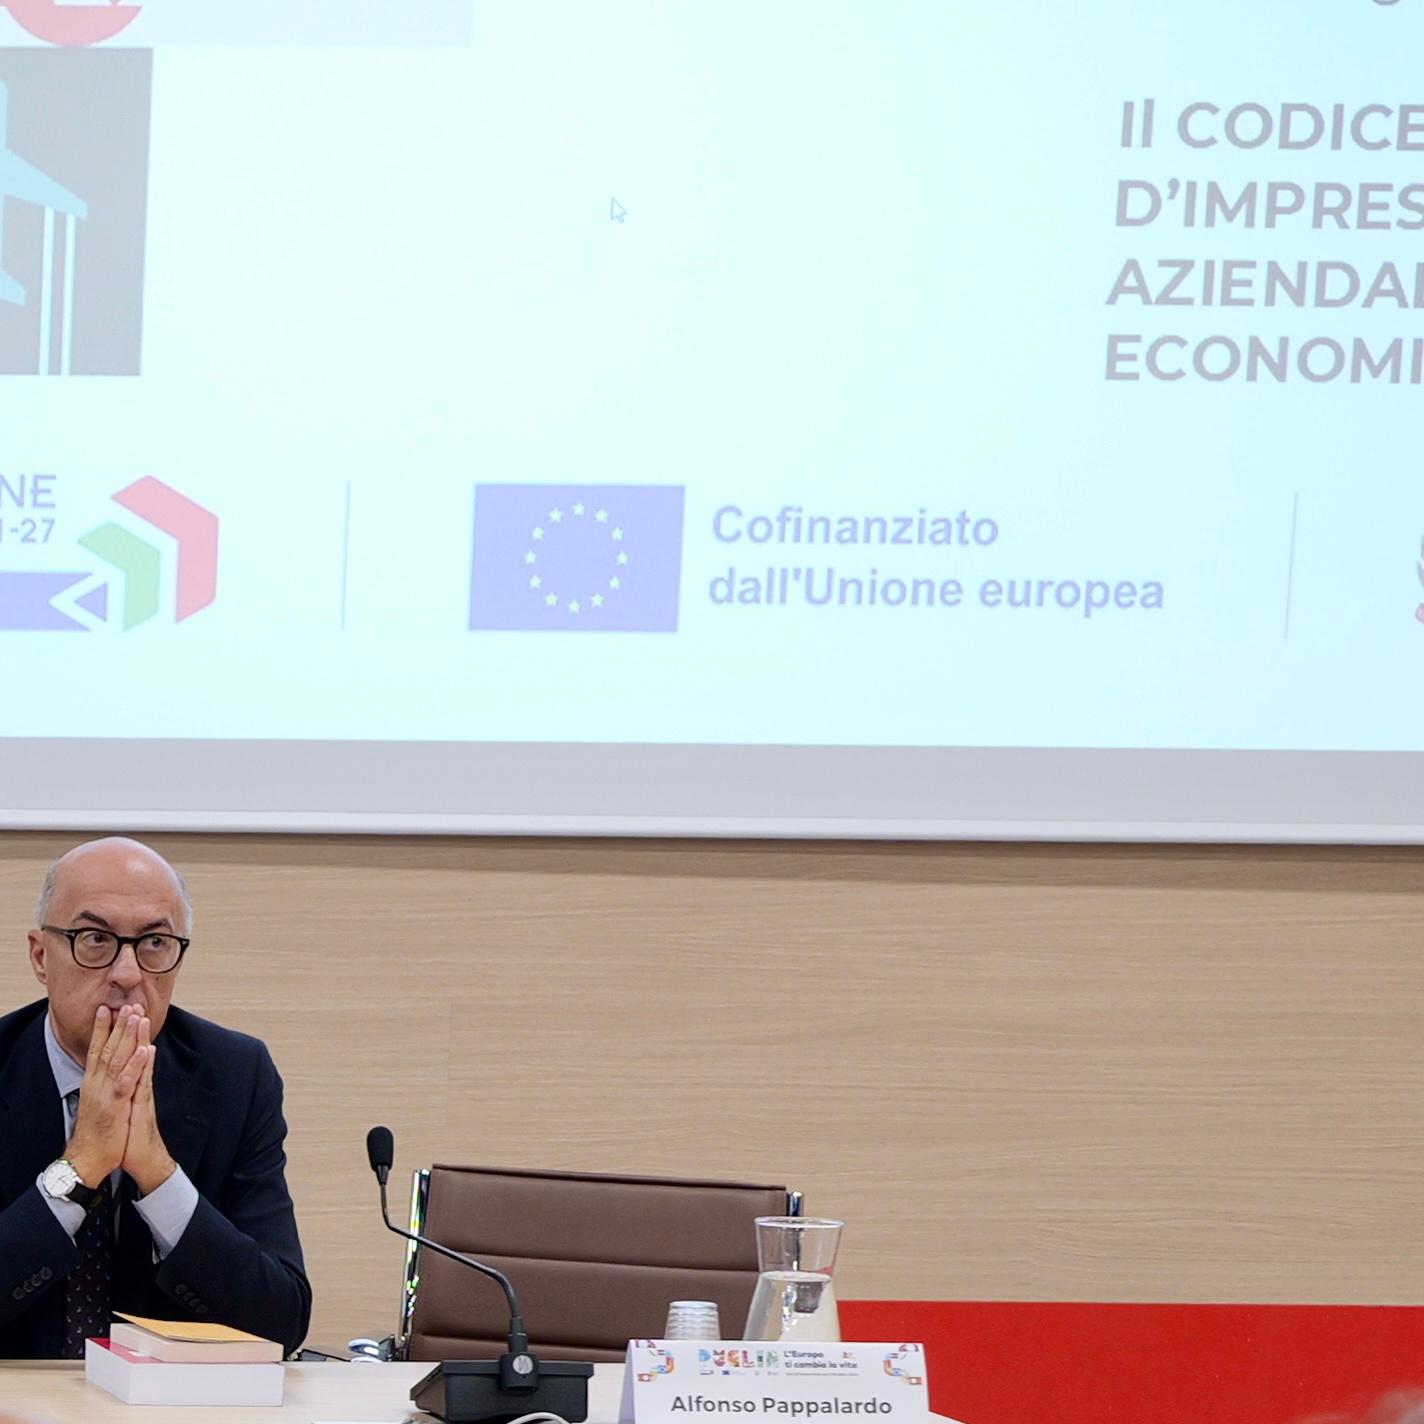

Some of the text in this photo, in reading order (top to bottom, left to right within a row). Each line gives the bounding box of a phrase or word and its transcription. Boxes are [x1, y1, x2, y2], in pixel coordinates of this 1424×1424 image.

[1120, 97, 1424, 152] Il CODICE
[1104, 257, 1424, 310] AZIENDA
[711, 504, 999, 548] Cofinanziato
[708, 565, 1165, 619] dall'Unione europea
[670, 1395, 893, 1419] Alfonso Pappalardo
